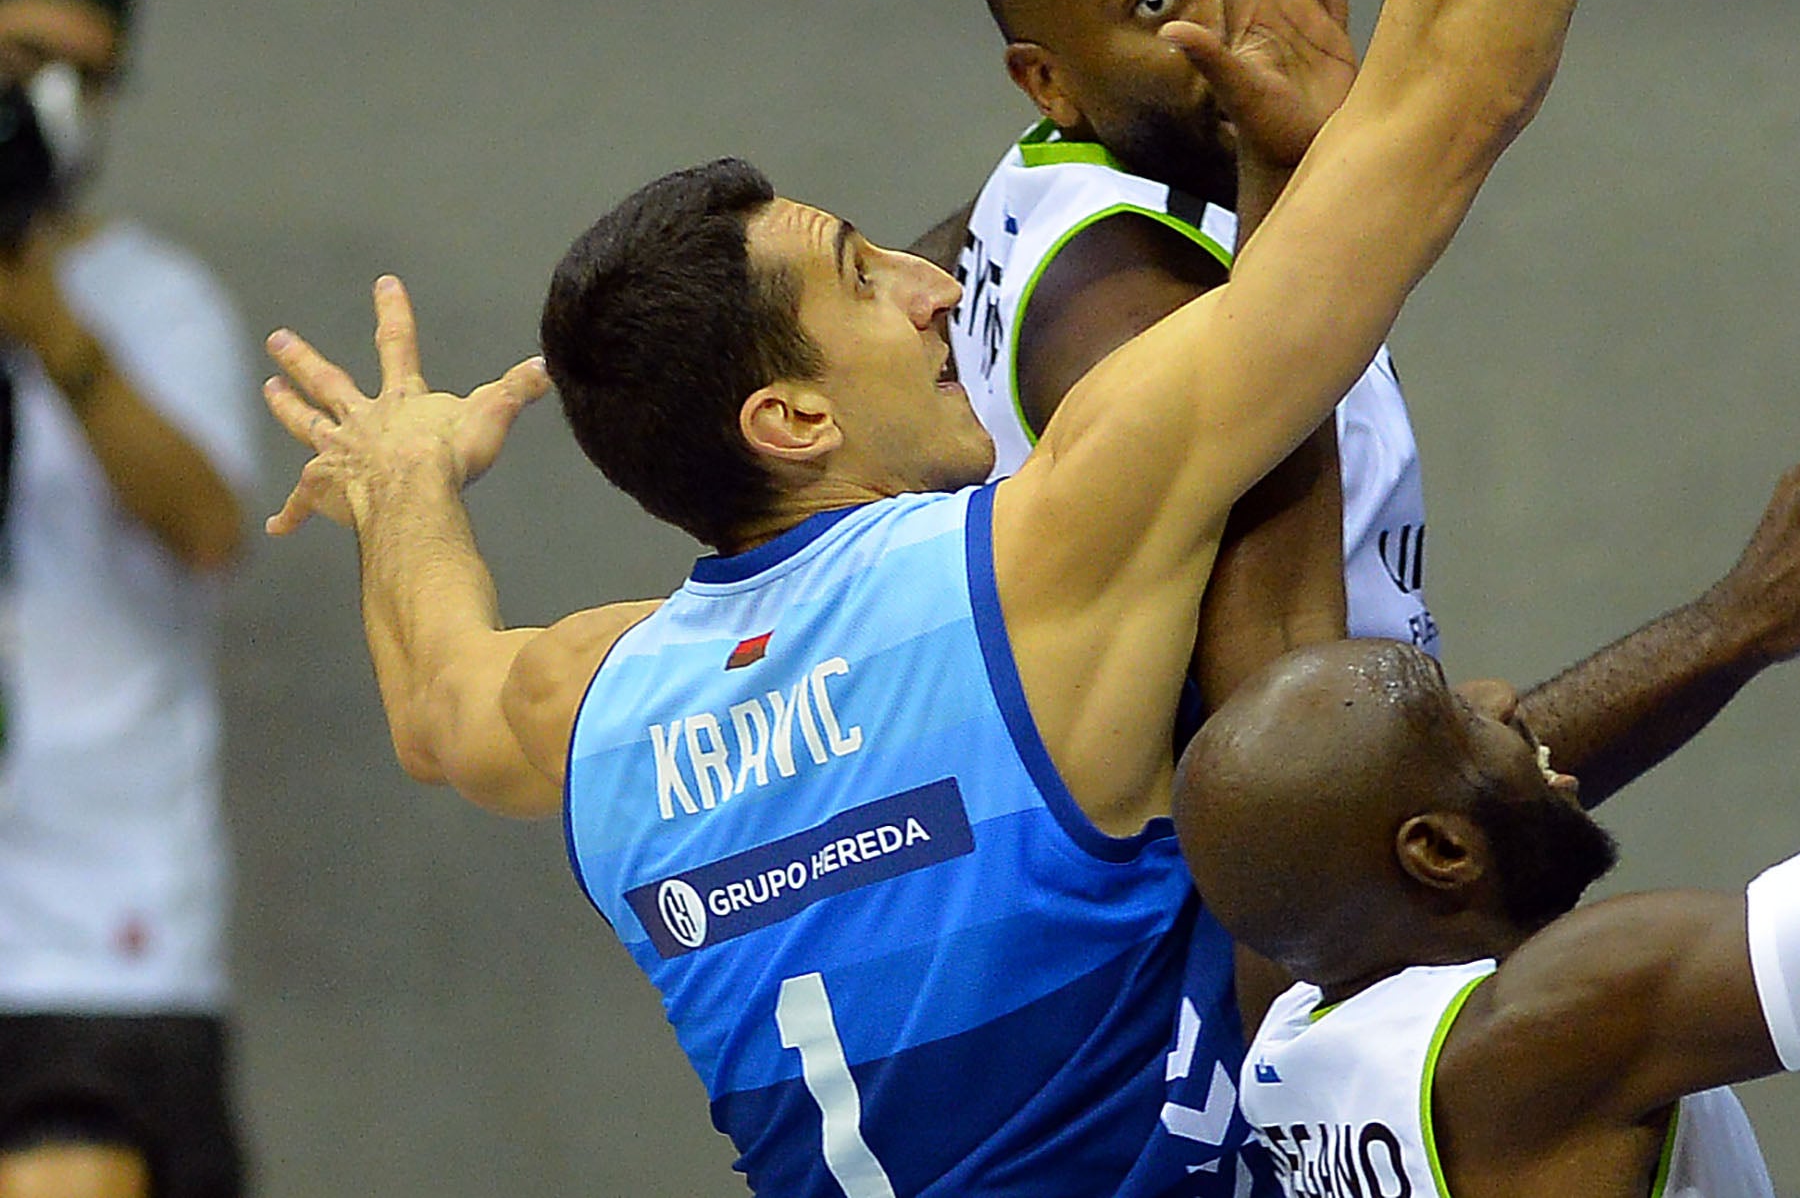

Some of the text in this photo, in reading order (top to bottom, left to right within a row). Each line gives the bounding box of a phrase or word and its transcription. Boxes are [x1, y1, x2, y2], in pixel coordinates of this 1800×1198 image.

[649, 656, 864, 821] KRAVIC
[708, 816, 931, 916] GRUPO HEREDA
[774, 971, 896, 1198] 1
